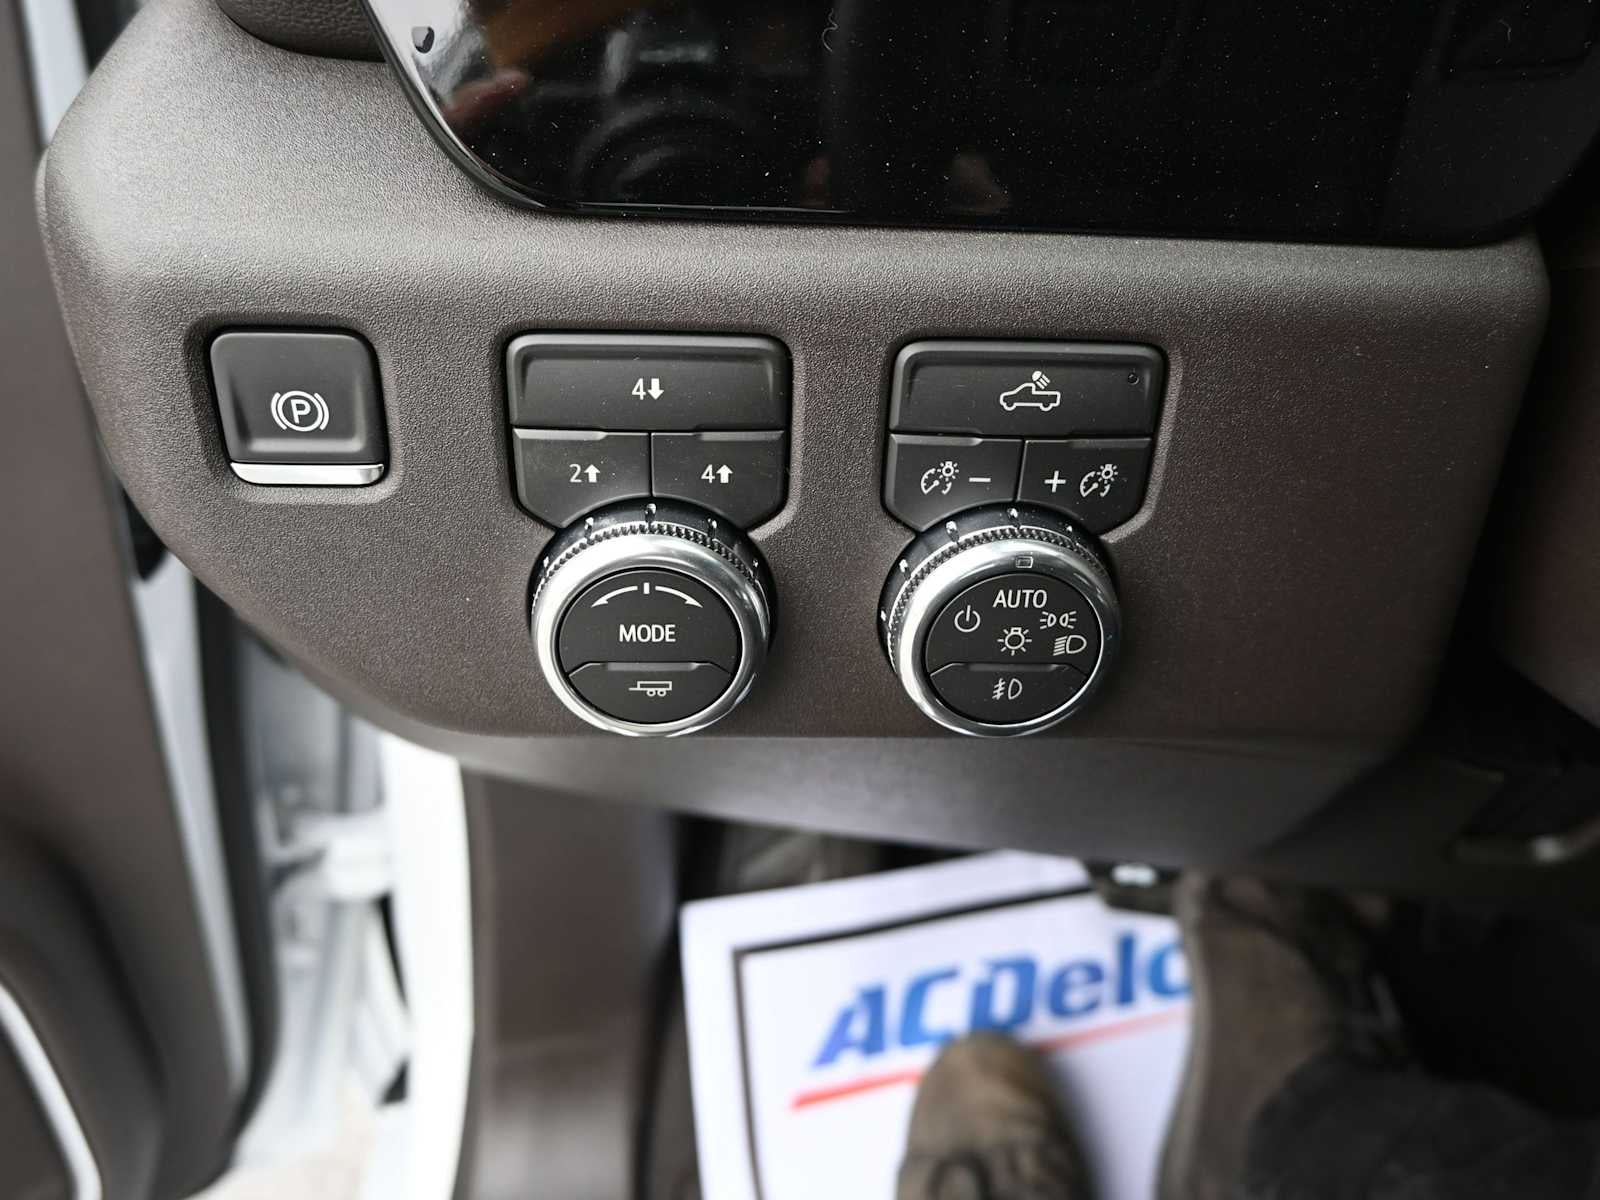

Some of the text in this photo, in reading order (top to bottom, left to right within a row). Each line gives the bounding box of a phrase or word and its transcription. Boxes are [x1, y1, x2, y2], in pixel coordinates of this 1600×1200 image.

[631, 378, 646, 400] 4
[290, 399, 312, 424] P
[569, 463, 582, 483] 2
[701, 464, 715, 483] 4
[992, 589, 1048, 609] AUTO
[618, 624, 677, 643] MODE
